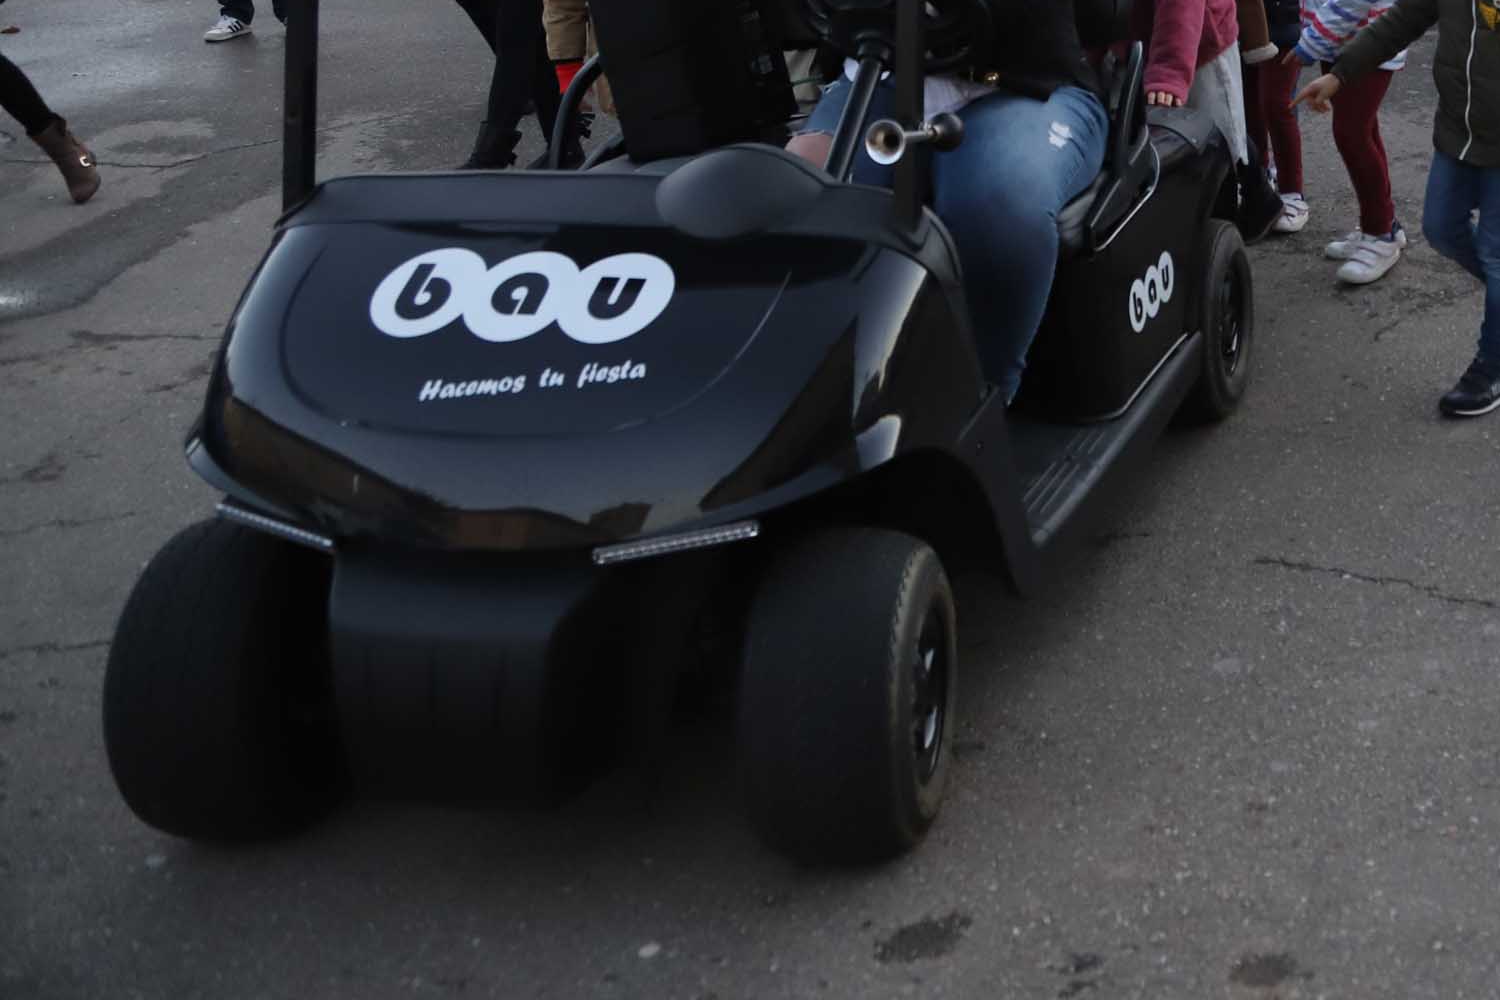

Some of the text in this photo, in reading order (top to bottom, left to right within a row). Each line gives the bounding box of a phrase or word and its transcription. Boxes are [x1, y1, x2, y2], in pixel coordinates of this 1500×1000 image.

[390, 260, 651, 323] bau
[1132, 262, 1170, 324] bau
[418, 358, 648, 402] Hacemos tu fiesta
